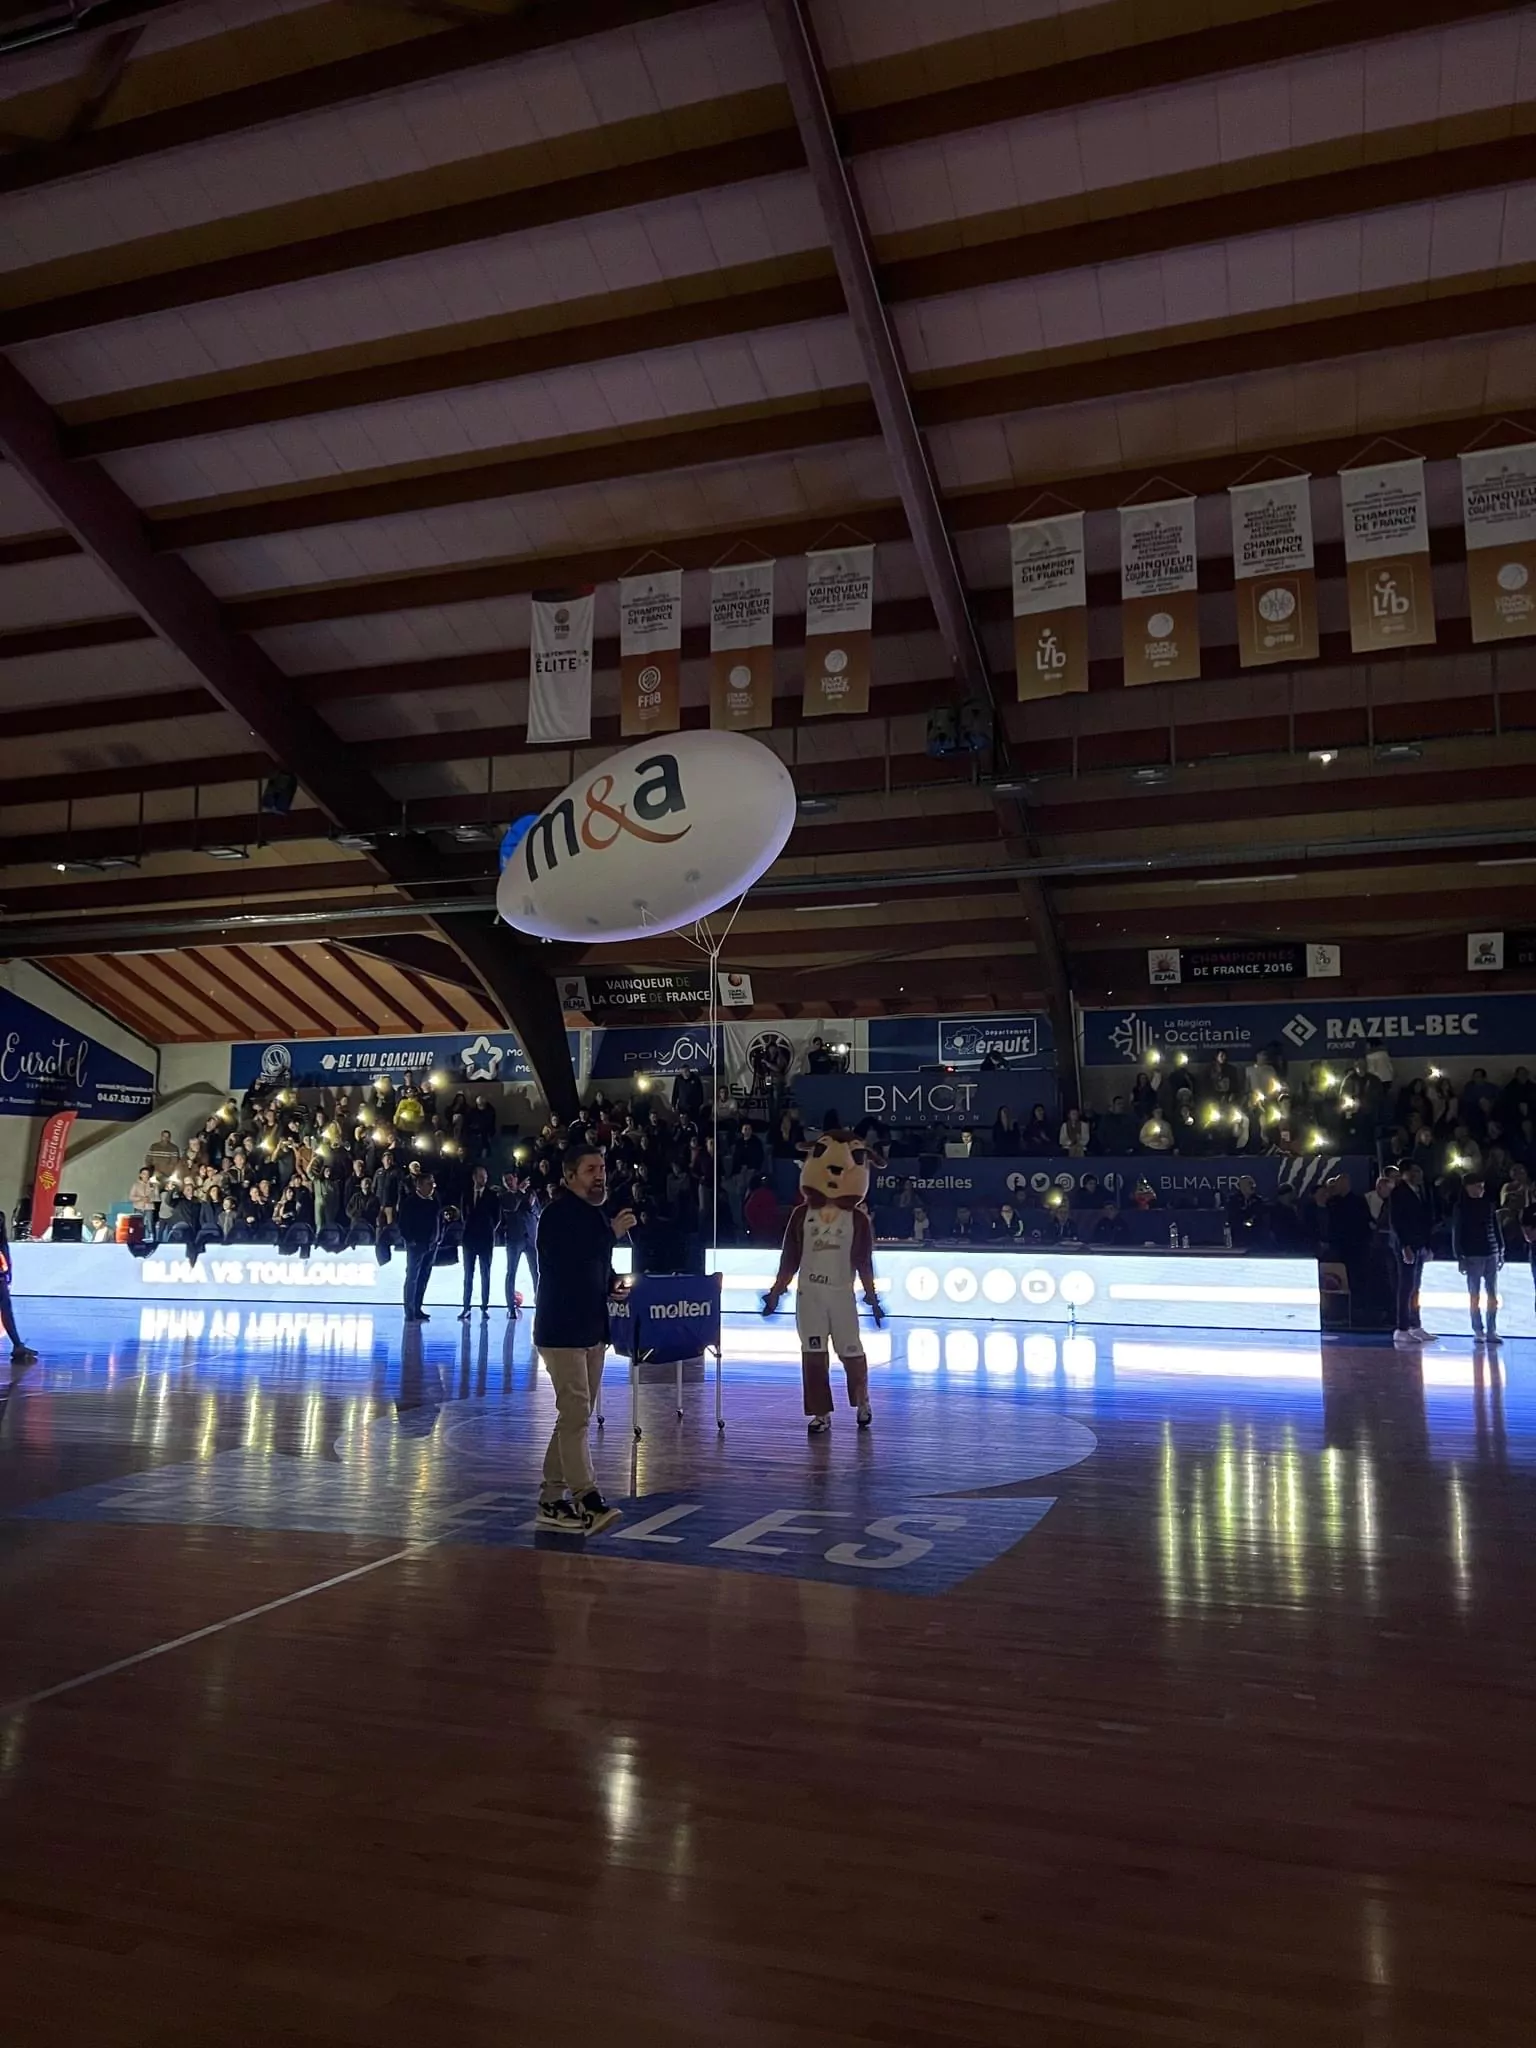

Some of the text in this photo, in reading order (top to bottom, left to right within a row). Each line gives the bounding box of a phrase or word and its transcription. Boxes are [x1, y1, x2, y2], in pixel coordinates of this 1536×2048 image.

[1354, 505, 1416, 523] CHAMPION
[1354, 514, 1416, 532] DE FRANCE
[1243, 535, 1302, 551] CHAMPION
[1243, 543, 1304, 560] DE FRANCE
[1022, 558, 1075, 575] CHAMPION
[1125, 555, 1193, 572] VAINQUEUR
[1022, 567, 1075, 584] DE FRANCE
[809, 582, 869, 597] VAINQUEUR
[628, 603, 673, 617] CHAMPION
[714, 598, 770, 613] VAINQUEUR
[627, 612, 673, 625] DE FRANCE
[526, 754, 692, 881] m&a
[1193, 962, 1293, 976] DE FRANCE 2016
[606, 976, 691, 990] VAINQUEUR DE
[592, 990, 712, 1005] LA COUPE DE FRANCE
[1165, 1026, 1251, 1042] Occitanie
[1326, 1013, 1480, 1039] RAZEL-BEC
[0, 1032, 89, 1088] Eurotel
[356, 1053, 377, 1067] YOU
[379, 1051, 434, 1067] COACHING
[864, 1084, 979, 1113] BMCT
[1160, 1175, 1240, 1190] BLMA.FR
[141, 1260, 378, 1287] BLMA VS TOULOUSE
[650, 1300, 712, 1319] molten
